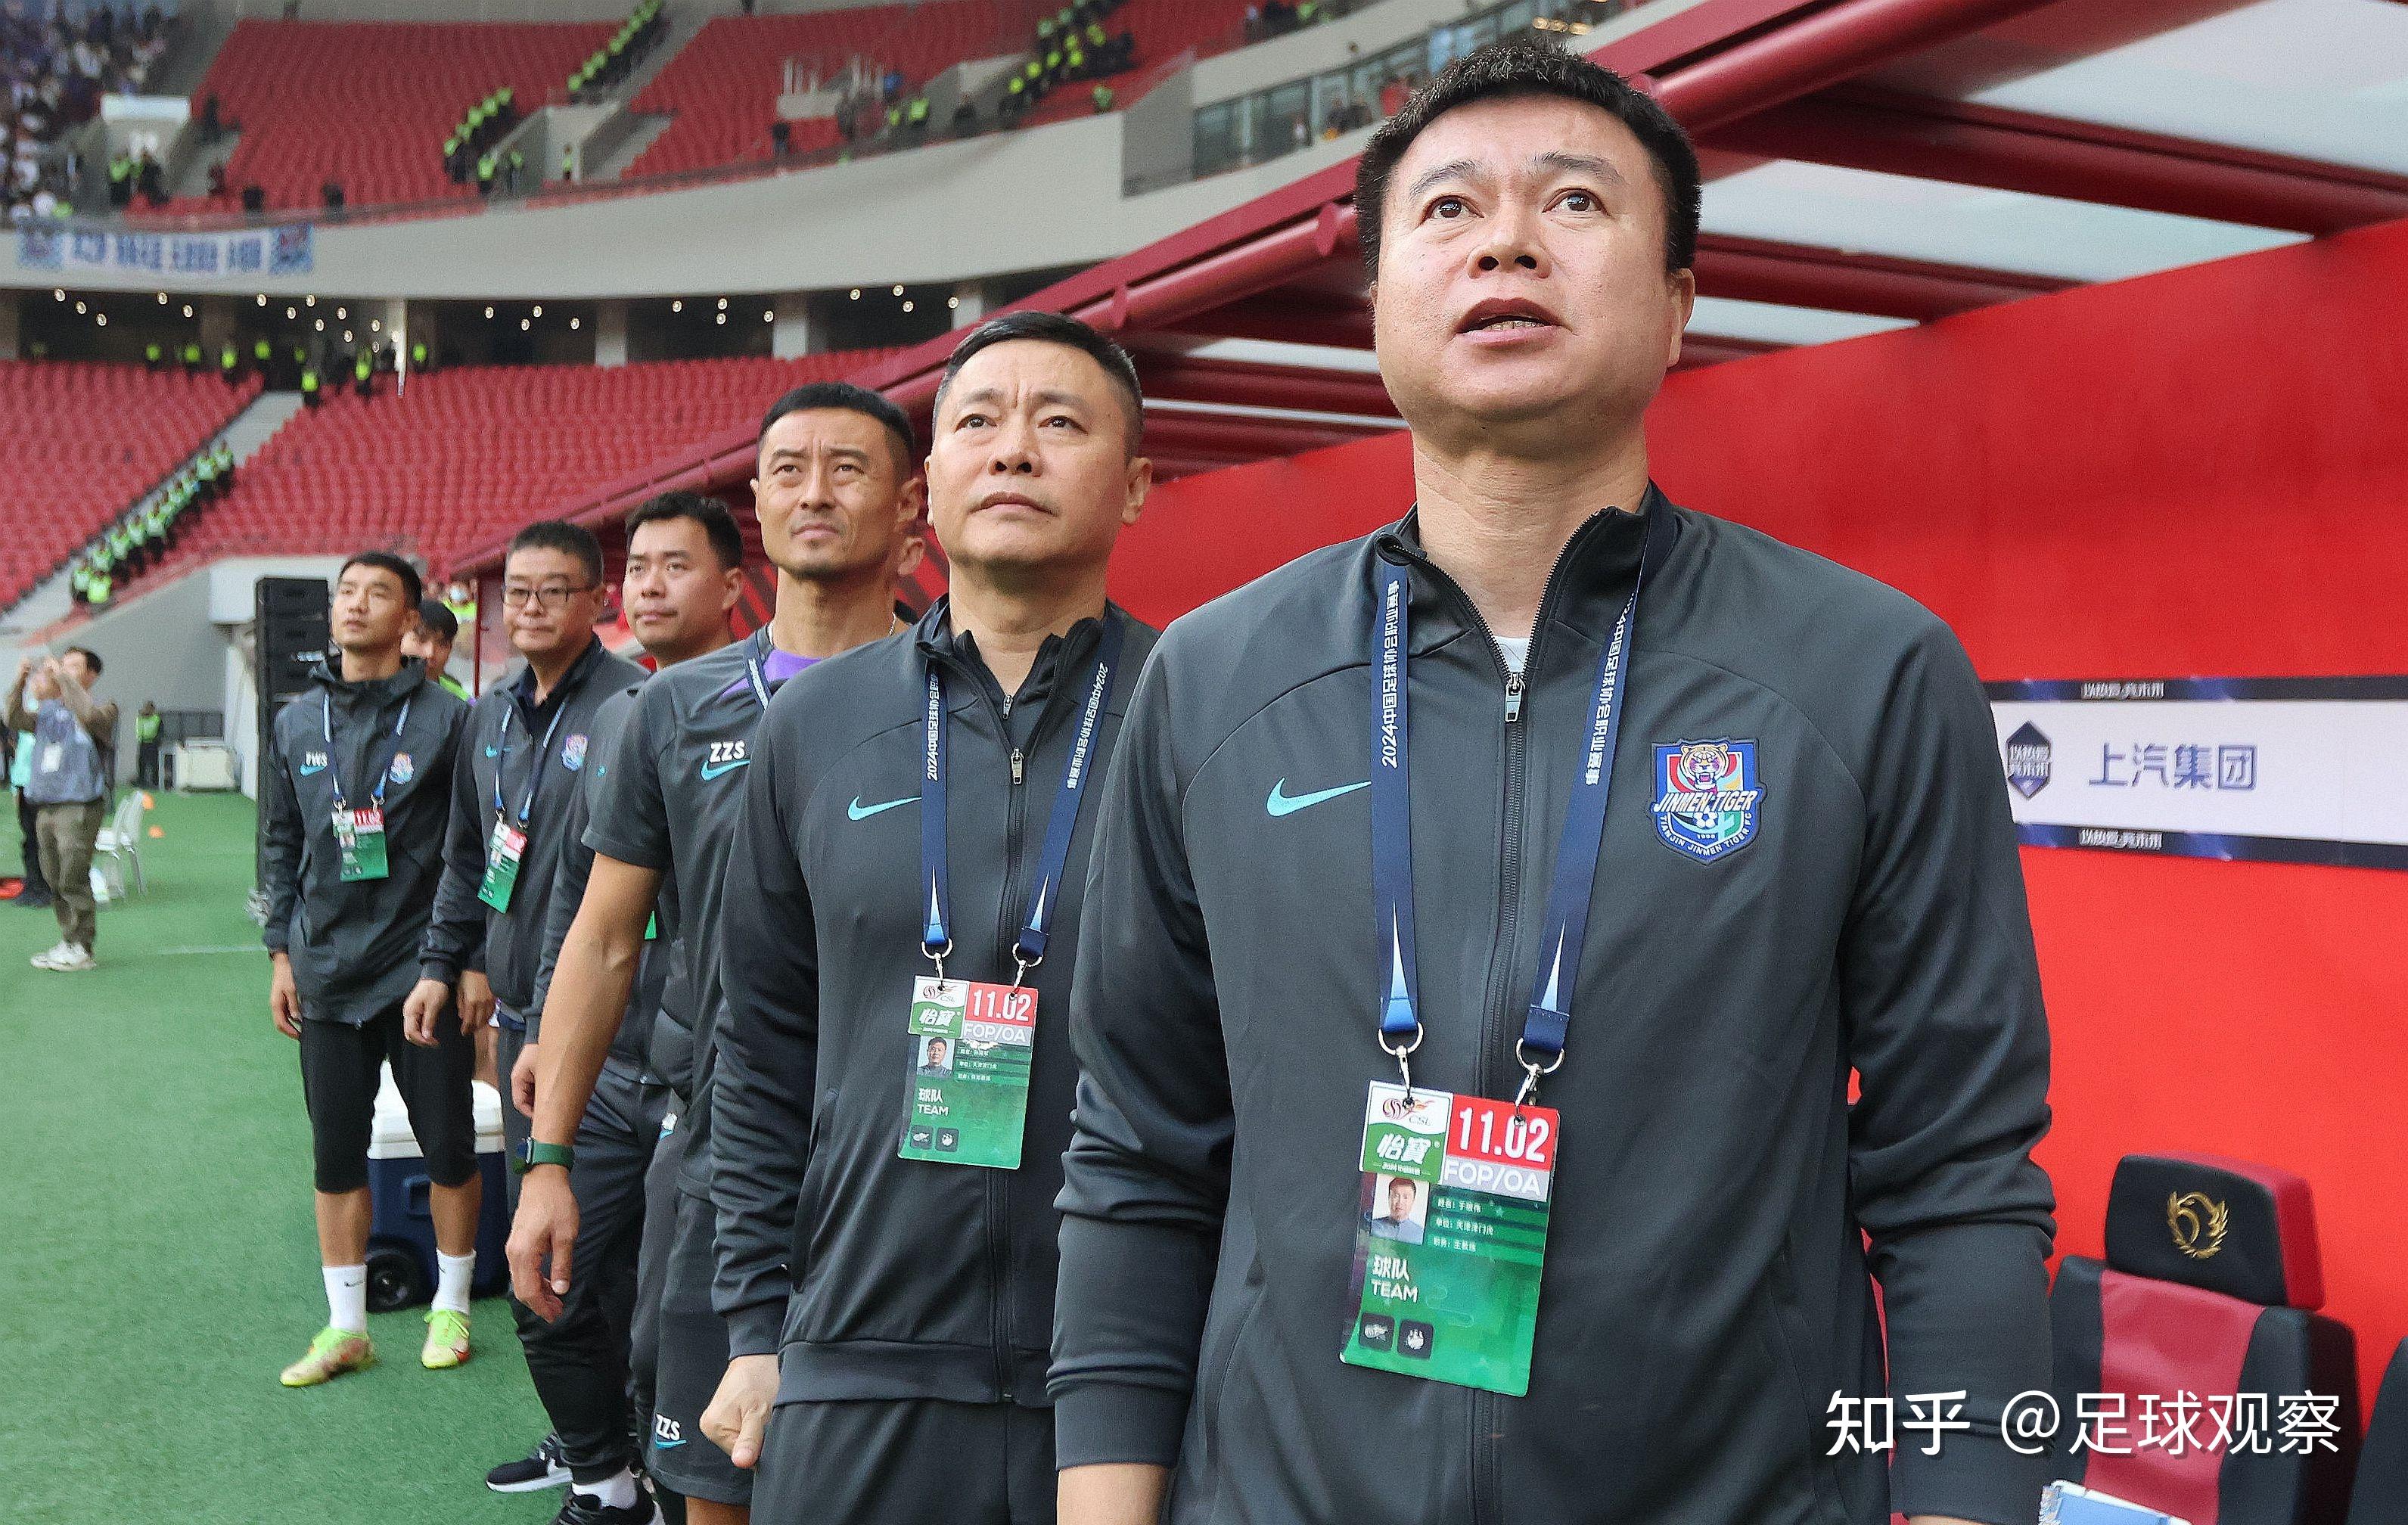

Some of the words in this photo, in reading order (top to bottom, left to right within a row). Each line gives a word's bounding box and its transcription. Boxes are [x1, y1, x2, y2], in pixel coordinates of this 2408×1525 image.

[1381, 580, 1400, 769] 2024中国足球协会职业赛事
[1586, 593, 1635, 786] 4中国足球协会职业赛事
[710, 740, 745, 763] ZZS
[2089, 743, 2257, 790] 上汽集团
[1654, 792, 1712, 812] JINMEN
[1710, 790, 1757, 812] TIGER
[1687, 844, 1723, 856] JINMEN
[973, 989, 1032, 1022] 11.02
[964, 1022, 1027, 1042] FOP/OA
[917, 1104, 949, 1117] TEAM
[1377, 1133, 1432, 1165] 怡寶
[1459, 1107, 1549, 1163] 11.02
[1444, 1159, 1541, 1197] FOP/OA
[1372, 1253, 1411, 1282] 球队
[1371, 1278, 1418, 1303] TEAM
